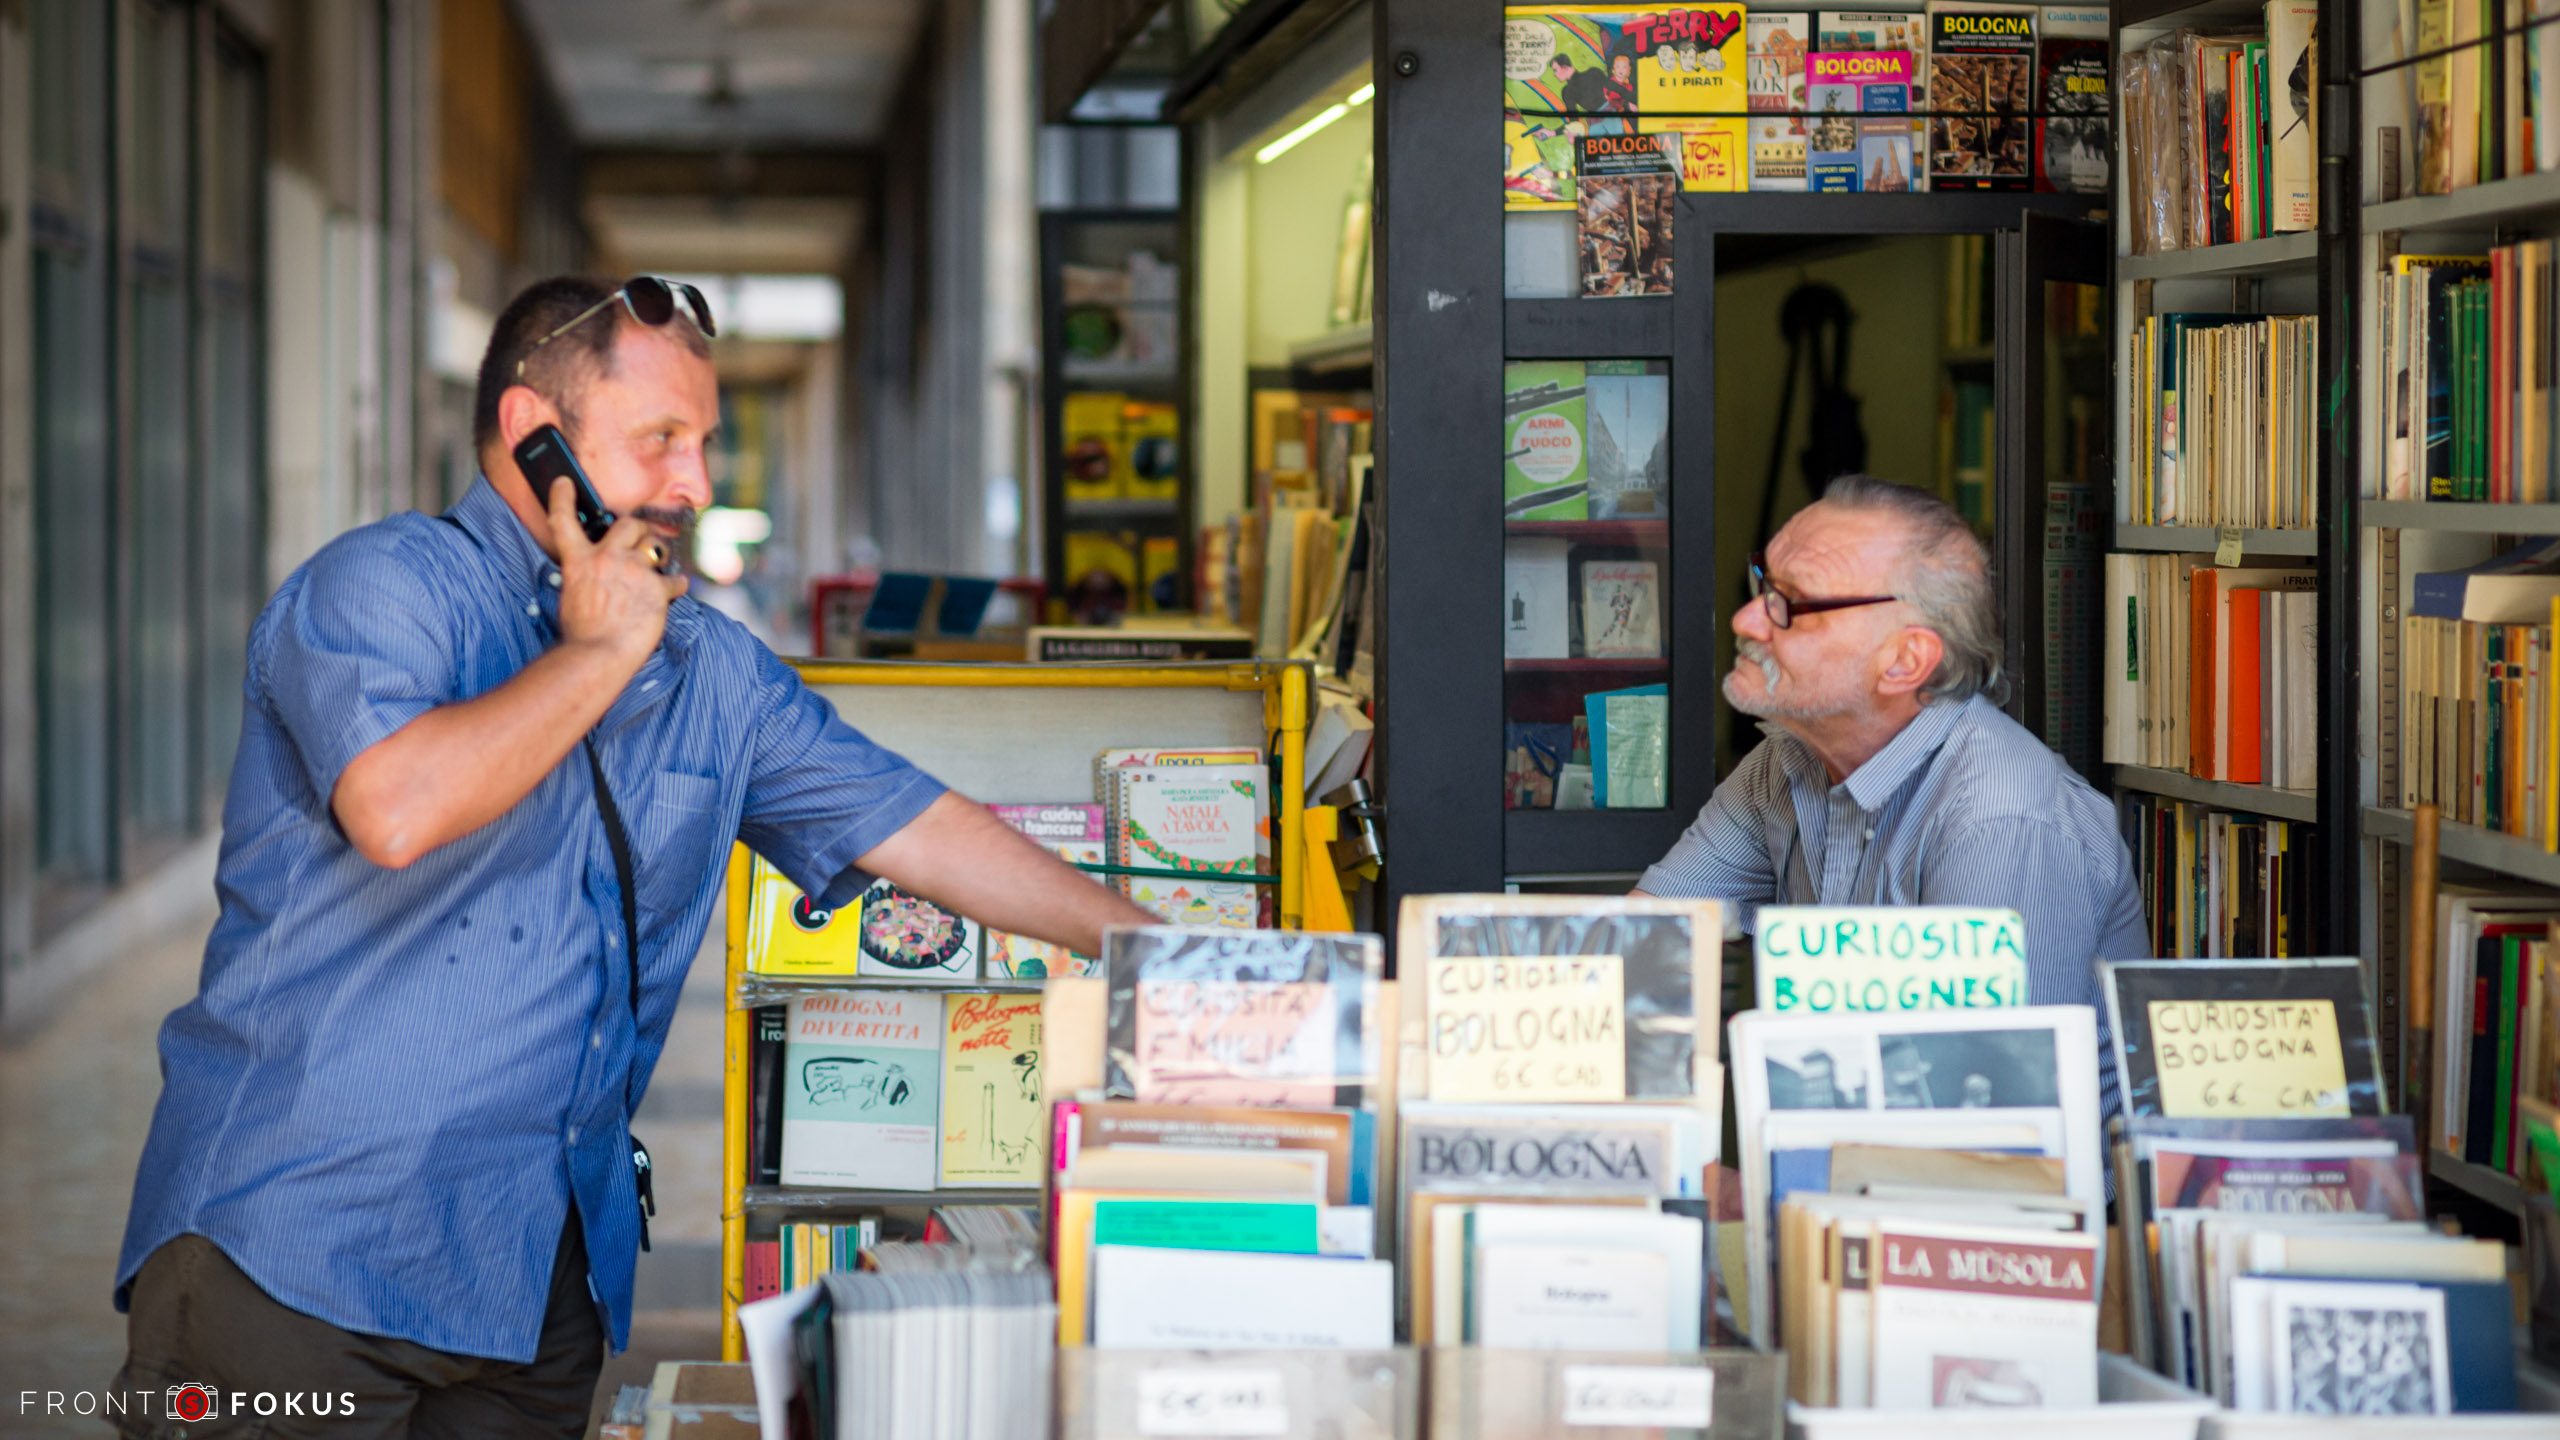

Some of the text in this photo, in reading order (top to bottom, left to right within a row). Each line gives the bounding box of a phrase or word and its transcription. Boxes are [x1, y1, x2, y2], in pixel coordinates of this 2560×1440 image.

[1943, 16, 2030, 35] BOLOGNA
[2047, 11, 2108, 24] Guida rapida
[1622, 9, 1740, 54] TERRY
[1816, 57, 1903, 75] BOLOGNA
[1659, 76, 1723, 87] E I PIRATI
[1746, 74, 1784, 93] OK
[2067, 76, 2107, 93] BOLOGNA
[1586, 136, 1673, 155] BOLOGNA
[1527, 418, 1565, 429] ARMI
[1520, 436, 1572, 449] FUOCO
[1040, 806, 1087, 823] cucina
[1165, 805, 1223, 819] NATALE
[1024, 820, 1086, 837] francese
[1171, 819, 1230, 834] TAVOLA
[801, 997, 903, 1017] BOLOGNA
[951, 993, 1042, 1033] Bologna
[801, 1019, 920, 1041] DIVERTITA
[1436, 1005, 1616, 1057] BOLOGNA
[959, 1028, 1013, 1053] notte
[2162, 1038, 2317, 1069] BOLOGNA
[1417, 1134, 1649, 1180] BOLOGNA
[2217, 1186, 2357, 1213] BOLOGNA
[1888, 1242, 1933, 1278] LA
